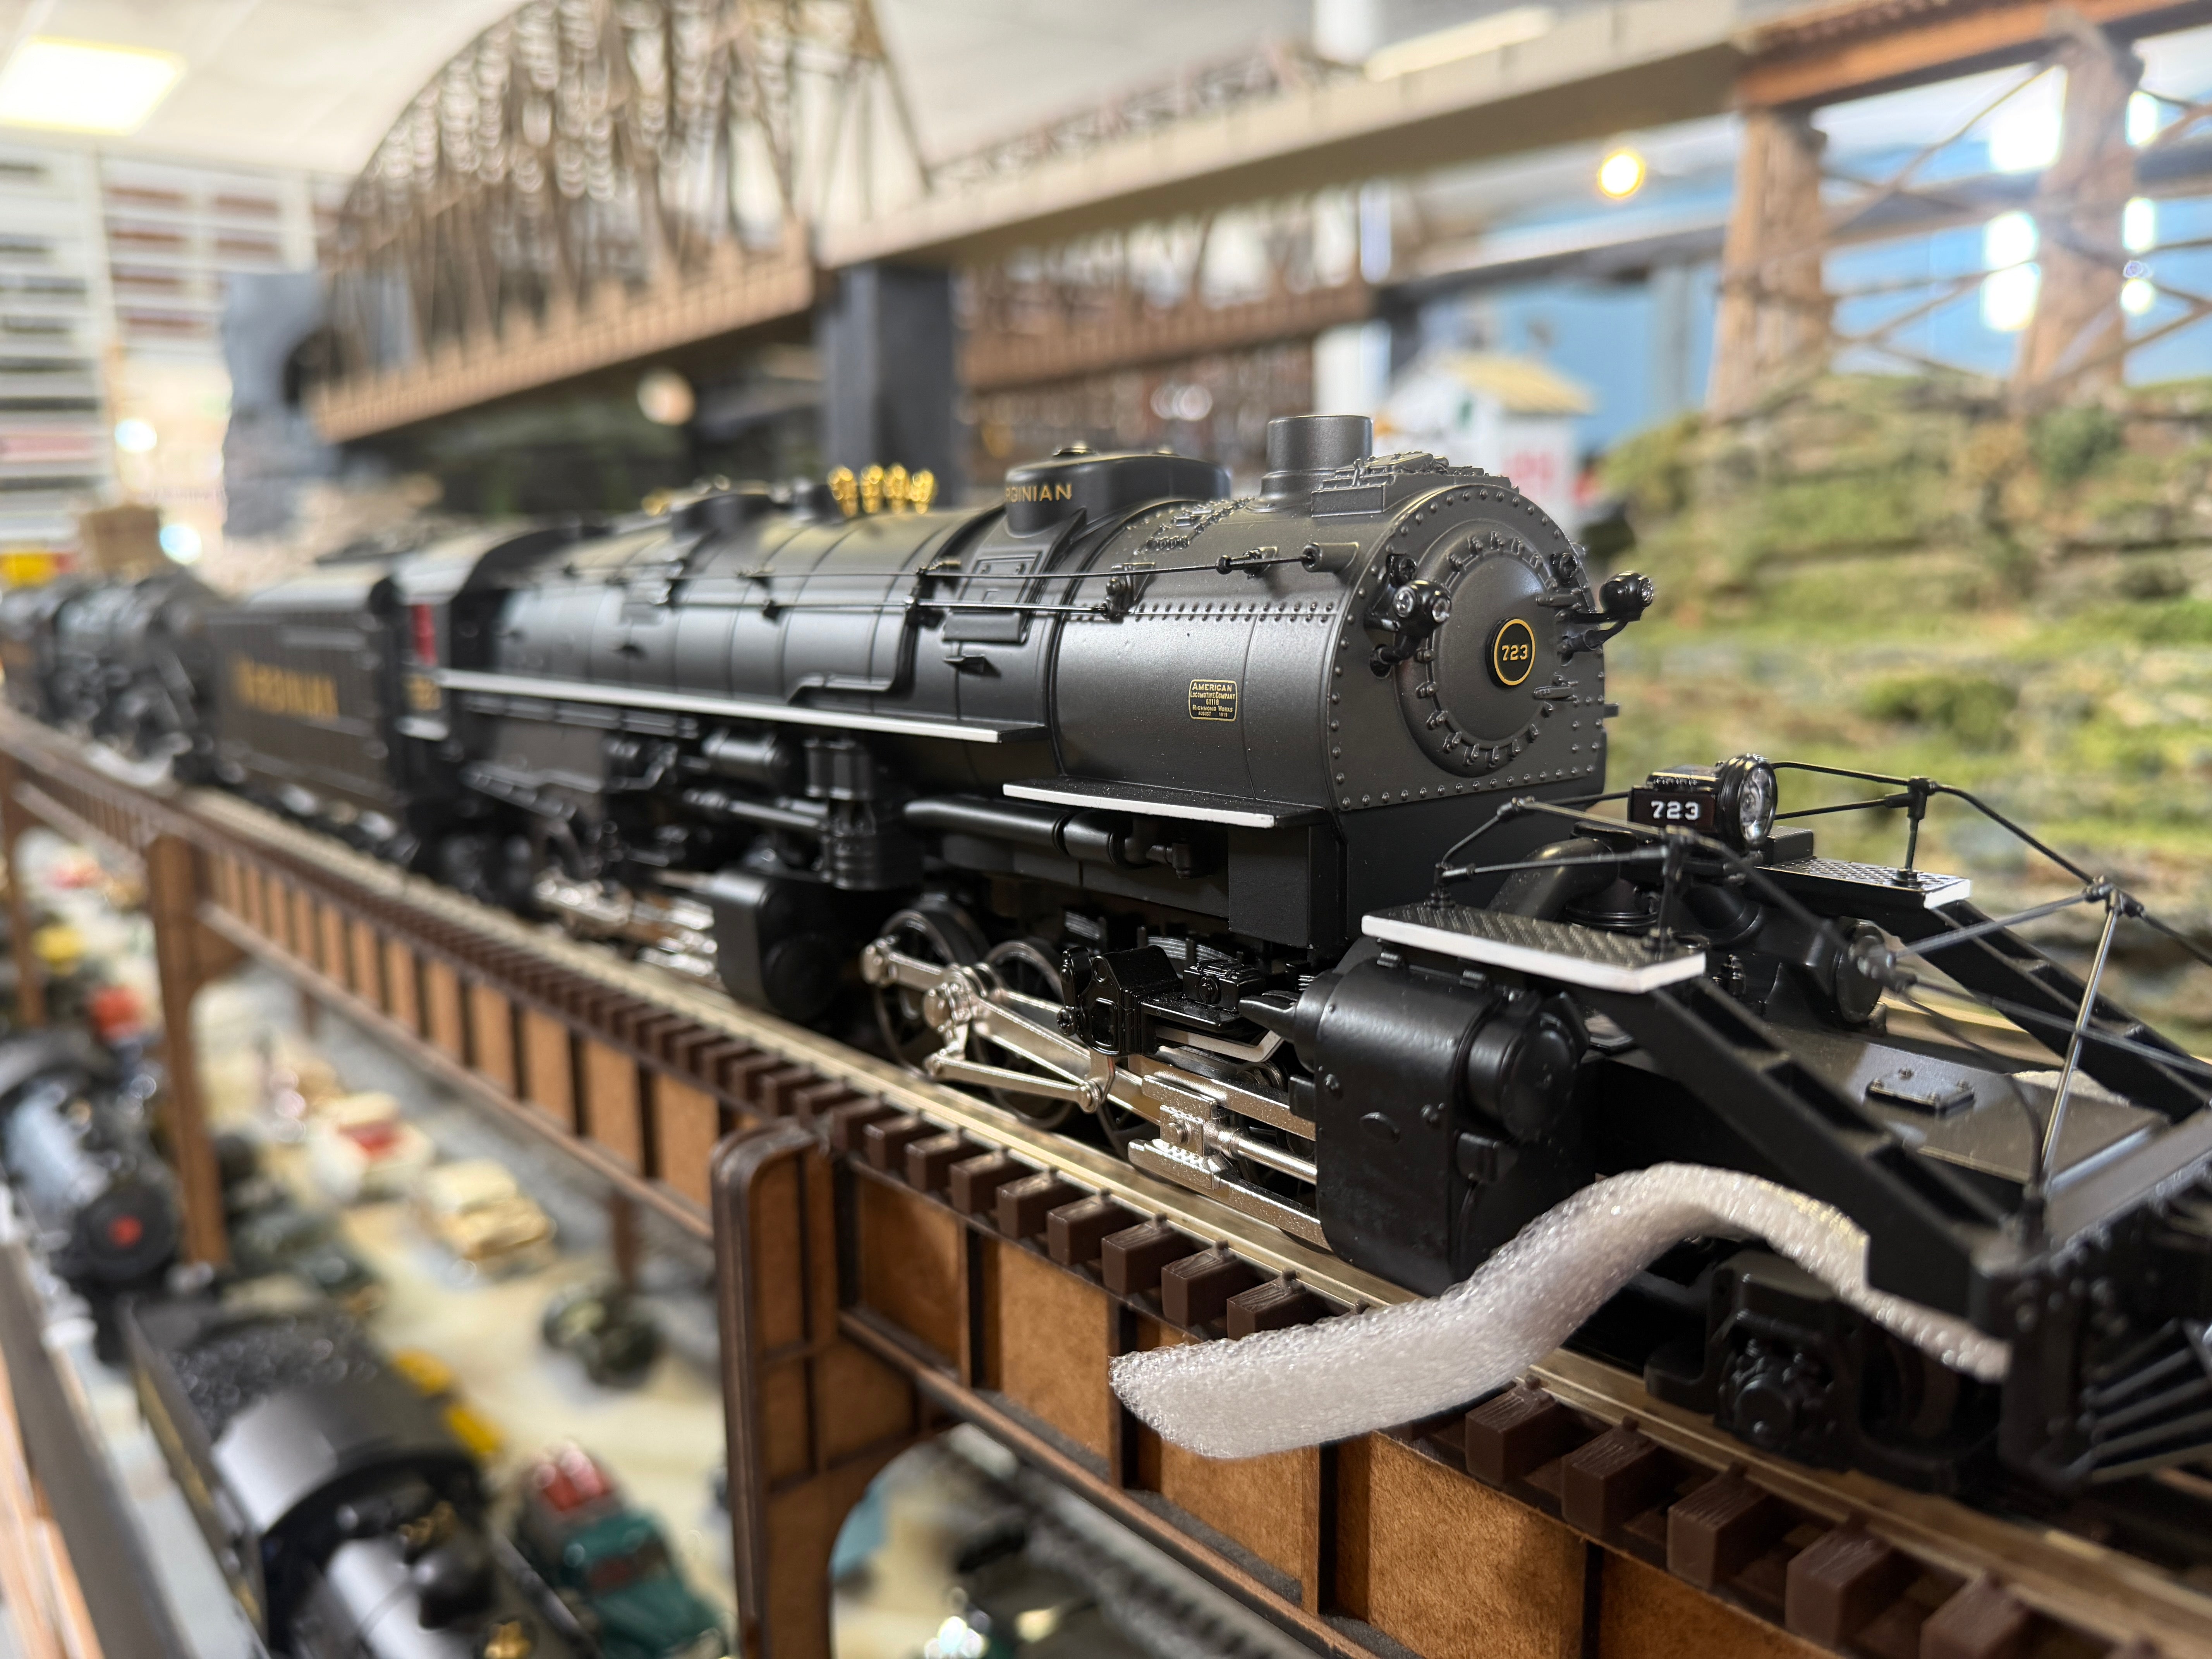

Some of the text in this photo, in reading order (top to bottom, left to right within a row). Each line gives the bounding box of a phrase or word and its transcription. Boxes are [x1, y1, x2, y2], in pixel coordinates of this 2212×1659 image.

[1502, 644, 1528, 661] 723
[1192, 682, 1232, 692] AMERICAN
[1215, 692, 1235, 700] COMPANY
[1651, 800, 1700, 821] 723
